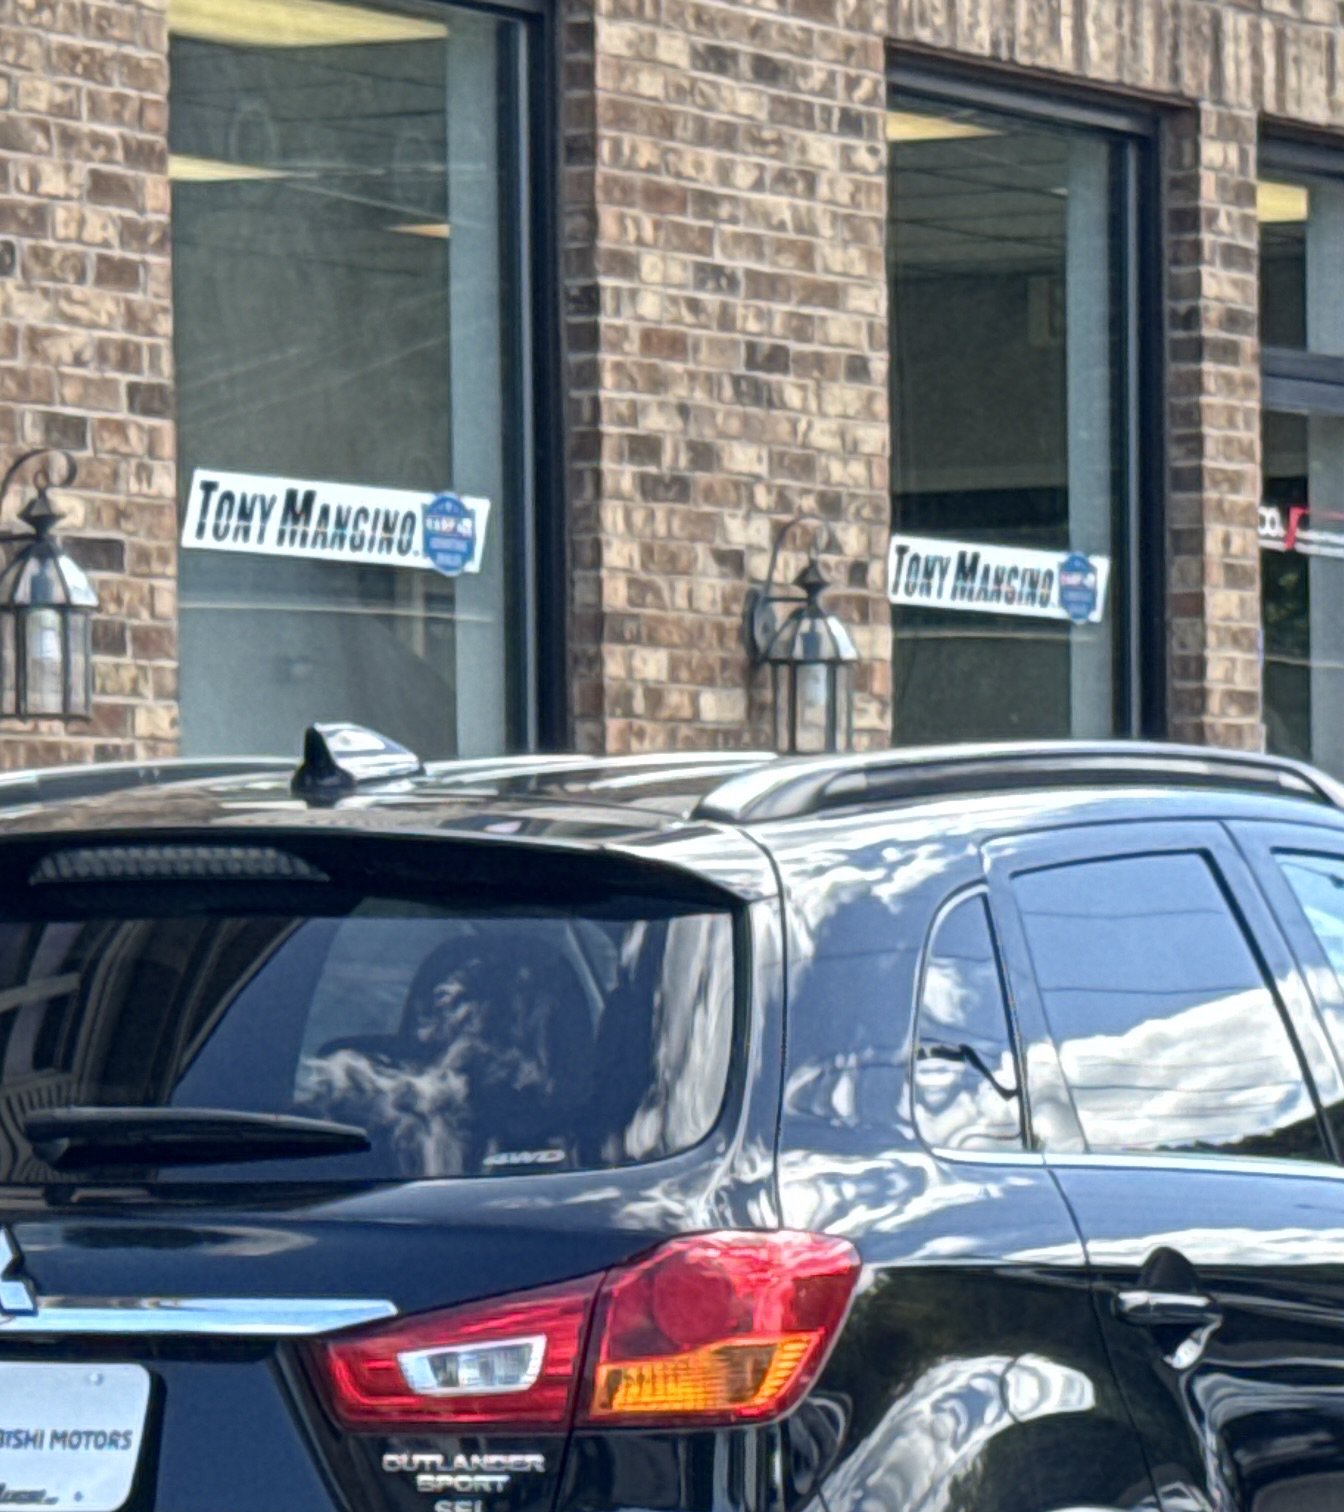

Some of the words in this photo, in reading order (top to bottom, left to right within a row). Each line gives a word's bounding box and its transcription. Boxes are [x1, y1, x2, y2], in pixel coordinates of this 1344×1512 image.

[49, 1429, 134, 1450] MOTORS
[382, 1453, 546, 1472] OUTLANDER
[416, 1474, 511, 1493] SPORT
